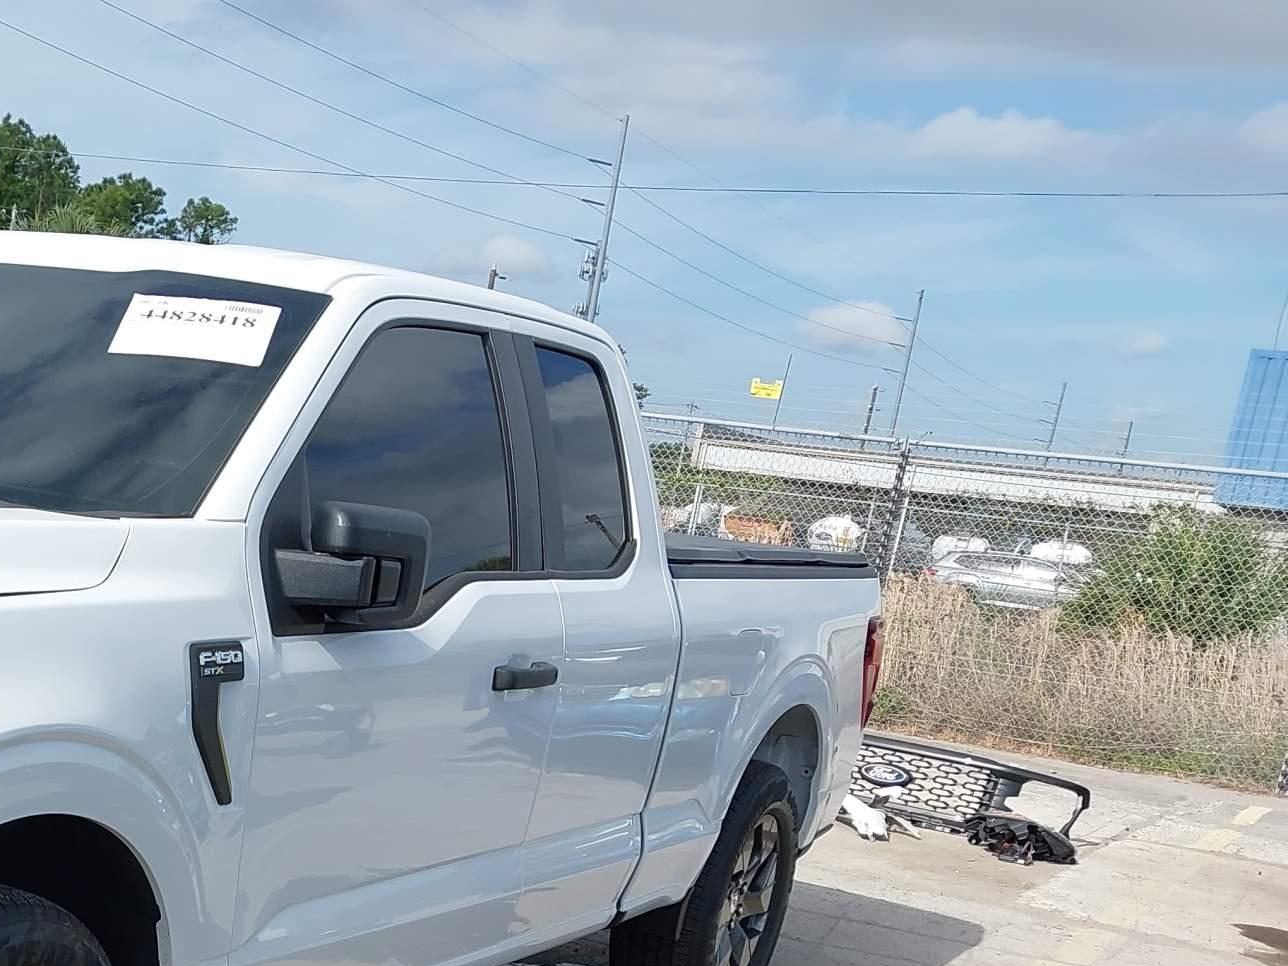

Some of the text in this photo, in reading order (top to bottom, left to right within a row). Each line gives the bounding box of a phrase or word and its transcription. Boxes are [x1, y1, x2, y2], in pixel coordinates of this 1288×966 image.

[140, 308, 257, 328] 44828418
[199, 650, 243, 665] F-150
[204, 666, 224, 676] STX
